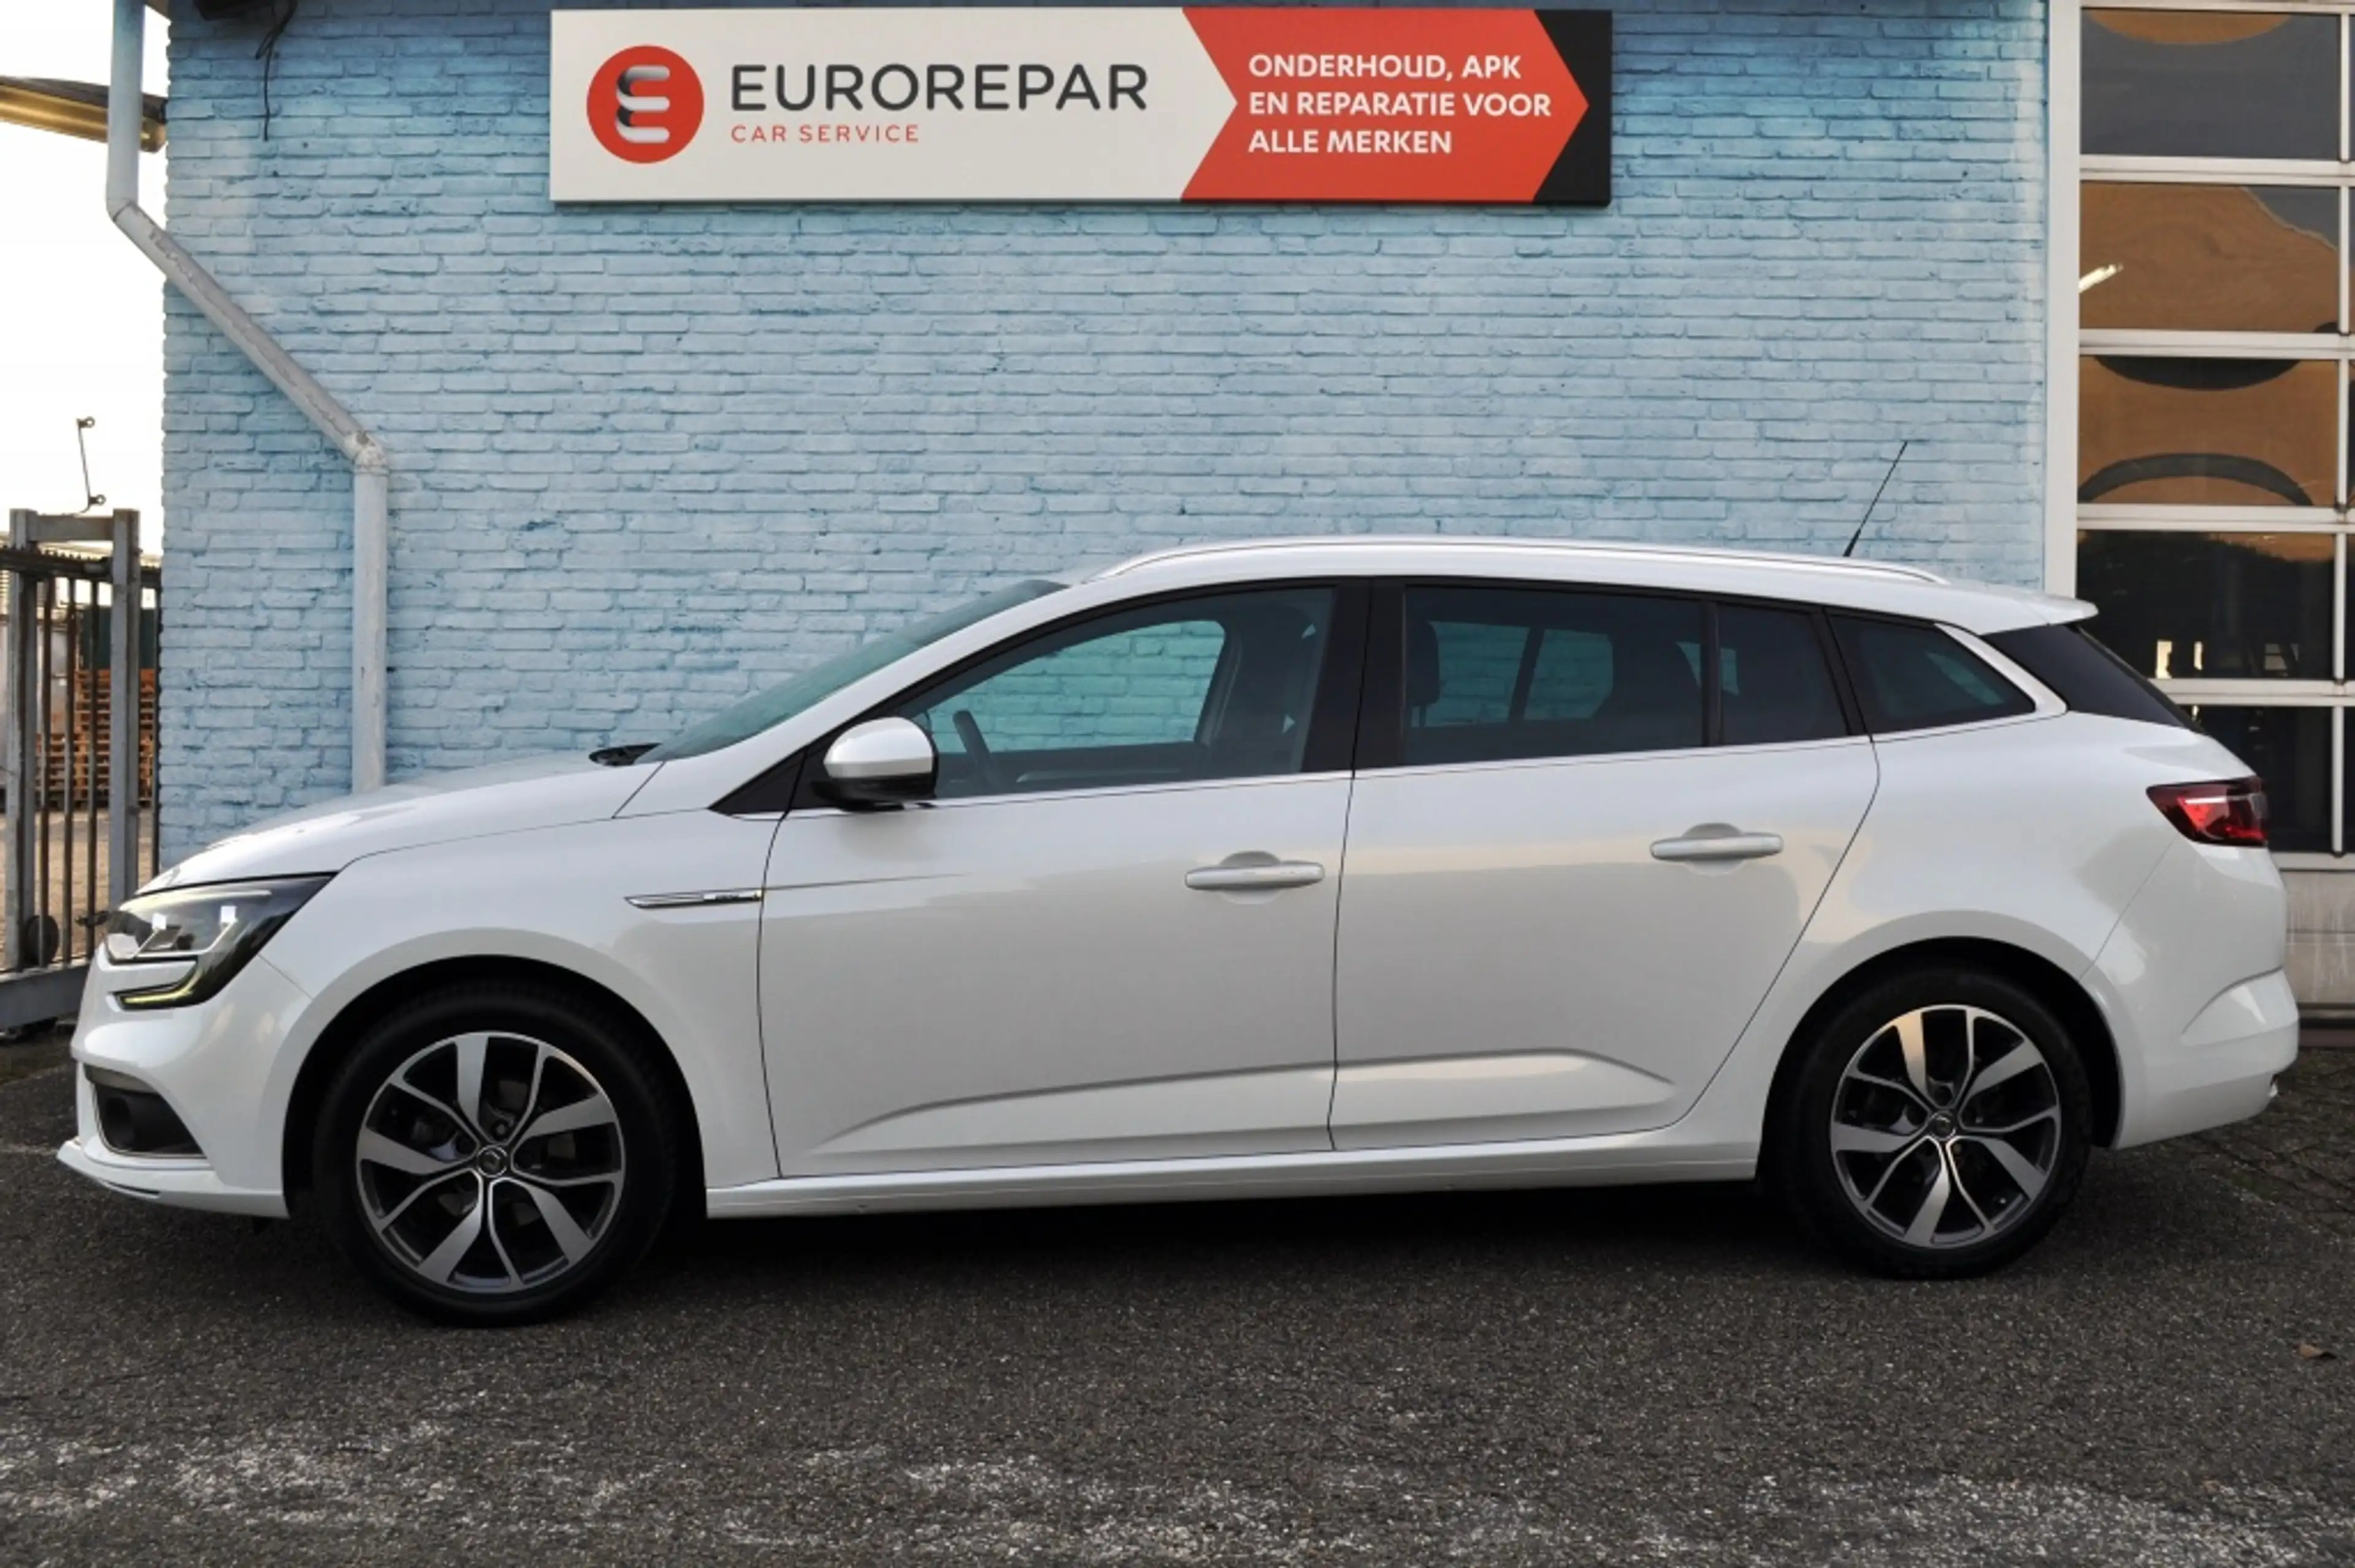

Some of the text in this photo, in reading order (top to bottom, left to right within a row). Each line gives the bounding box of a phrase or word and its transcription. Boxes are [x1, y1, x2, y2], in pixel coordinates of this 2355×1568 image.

[1249, 54, 1521, 81] ONDERHOUD, APK
[731, 64, 1147, 111] EUROREPAR
[1249, 91, 1551, 117] EN REPARATIE VOOR
[732, 124, 919, 143] CAR SERVICE
[1248, 130, 1452, 154] ALLE MERKEN
